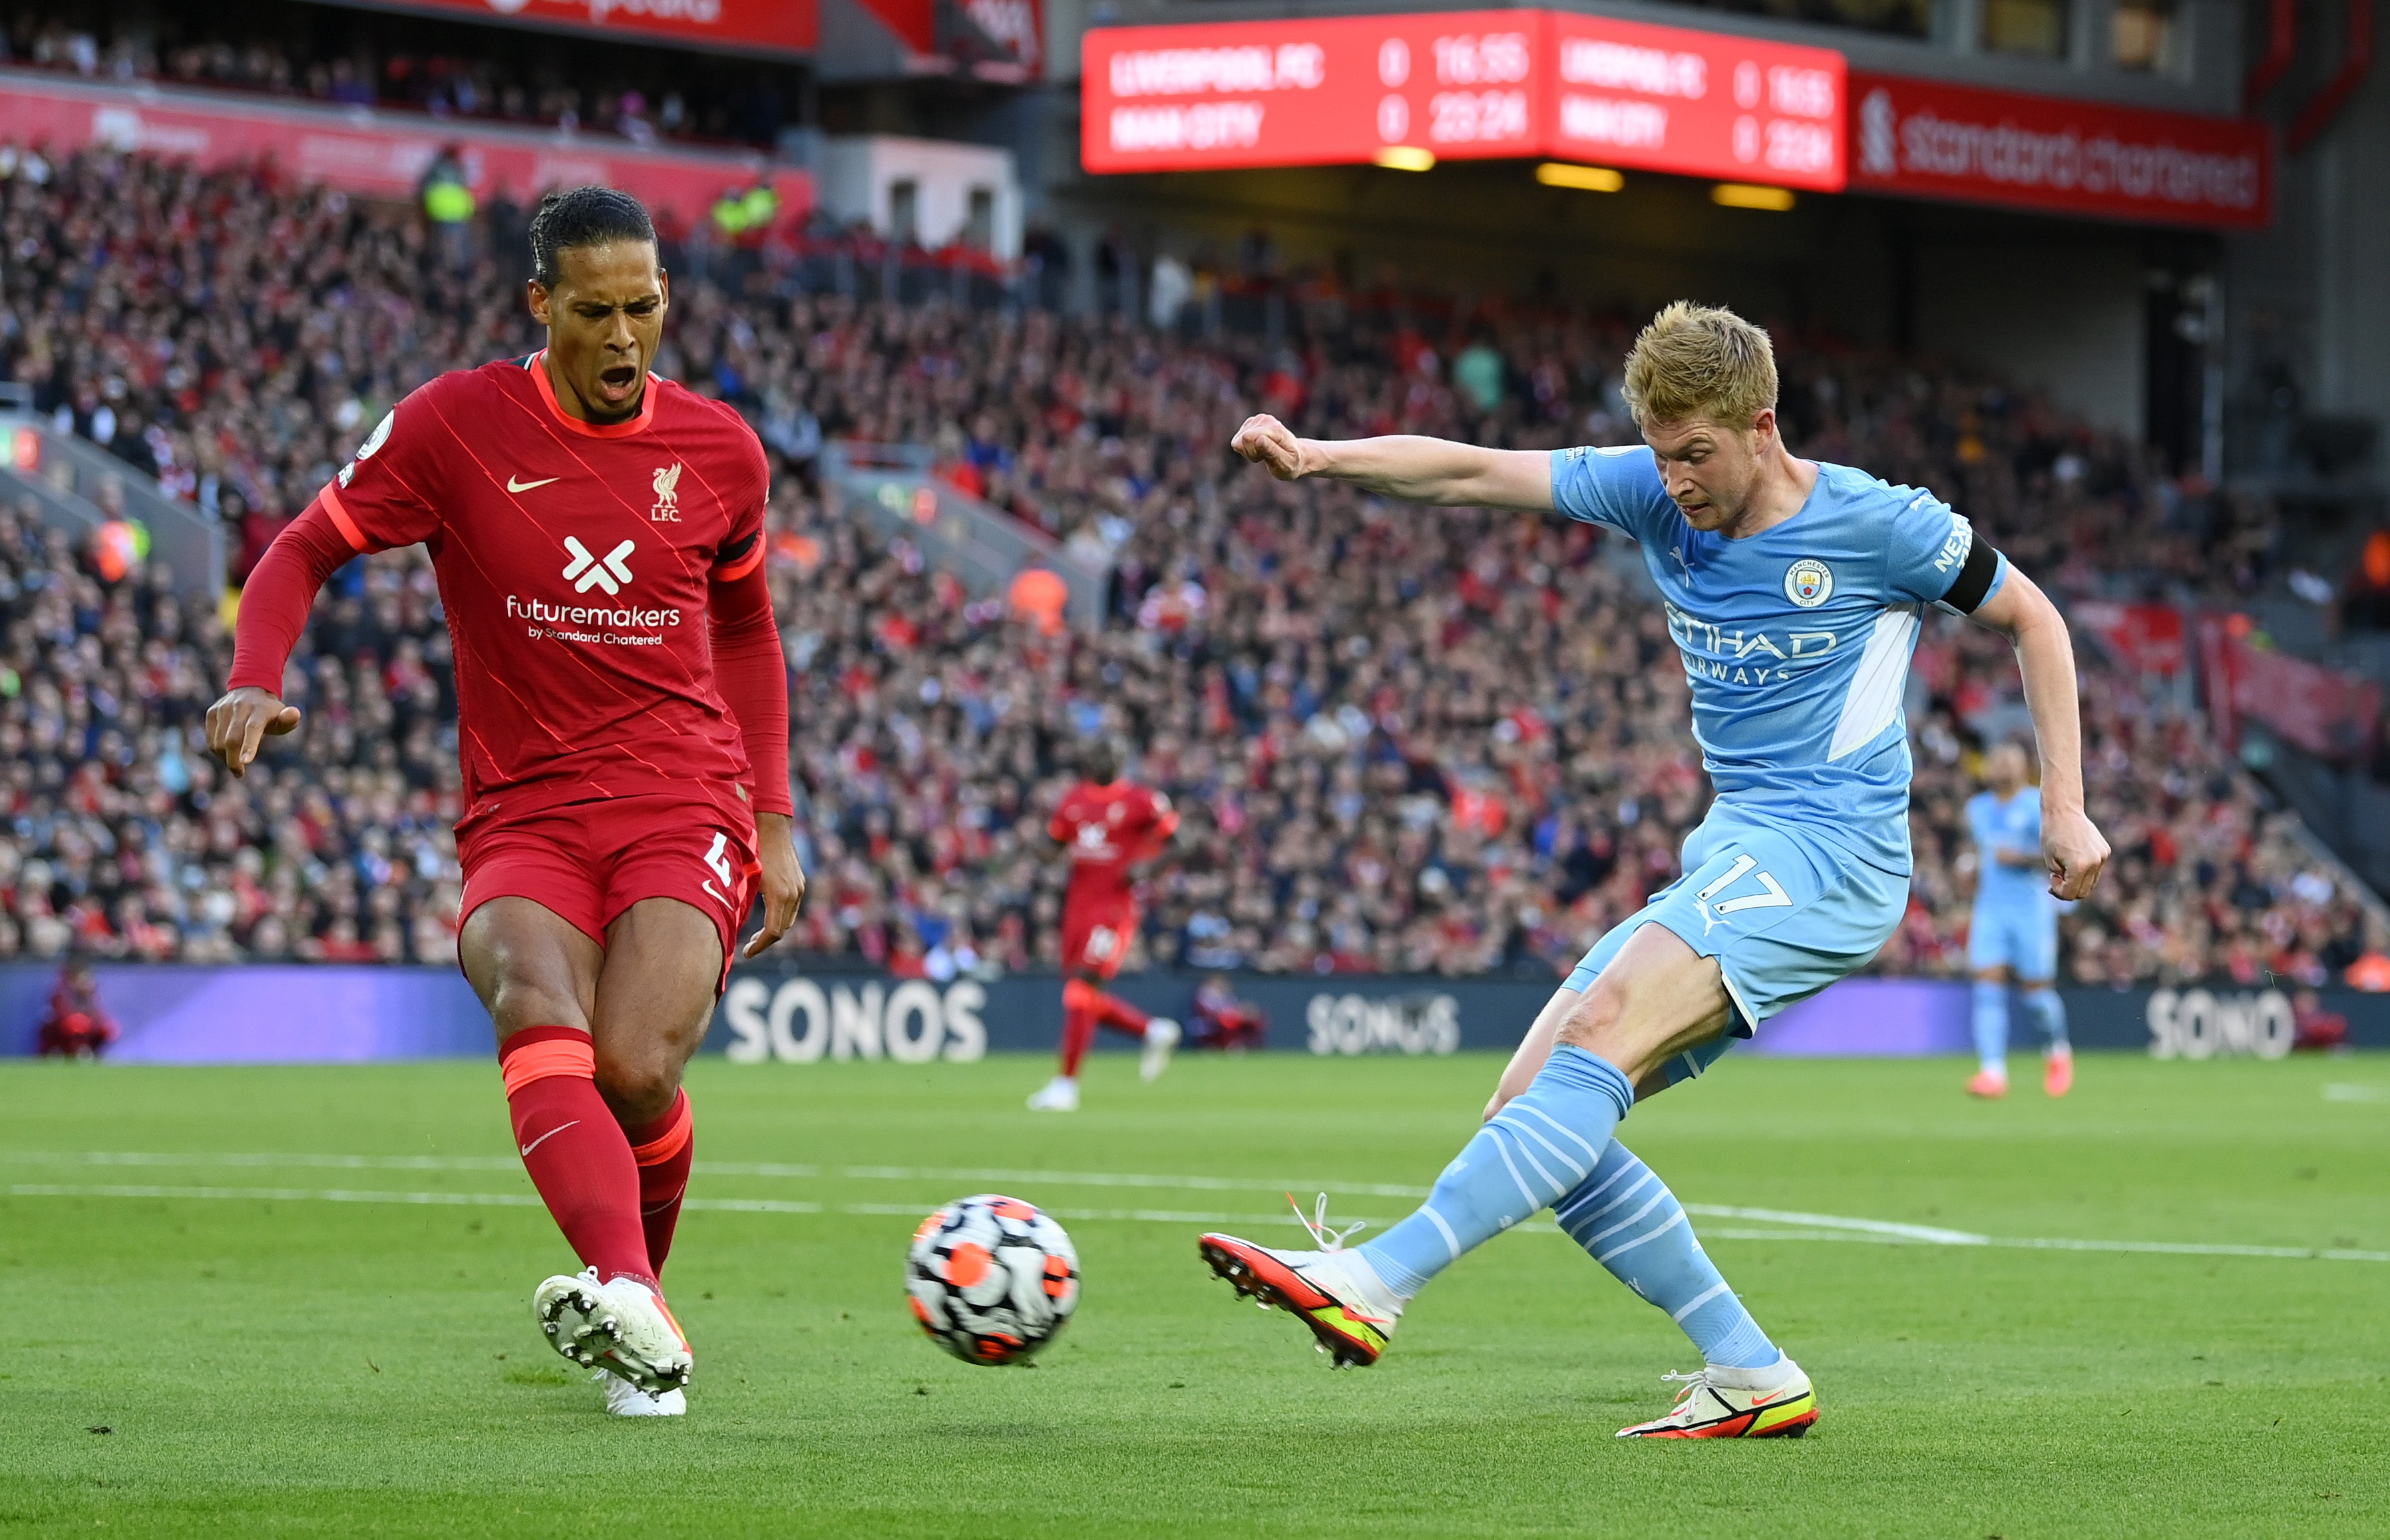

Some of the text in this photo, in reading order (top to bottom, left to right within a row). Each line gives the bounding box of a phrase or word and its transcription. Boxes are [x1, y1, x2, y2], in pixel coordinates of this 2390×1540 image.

[1789, 561, 1830, 578] MANCHESTER
[506, 595, 680, 627] futuremakers
[528, 626, 662, 646] by Standard Chartered
[1665, 600, 1837, 660] ETIHAD
[703, 831, 731, 888] 4
[1695, 853, 1794, 916] 17
[725, 977, 987, 1063] SONOS
[2146, 988, 2294, 1060] SONO
